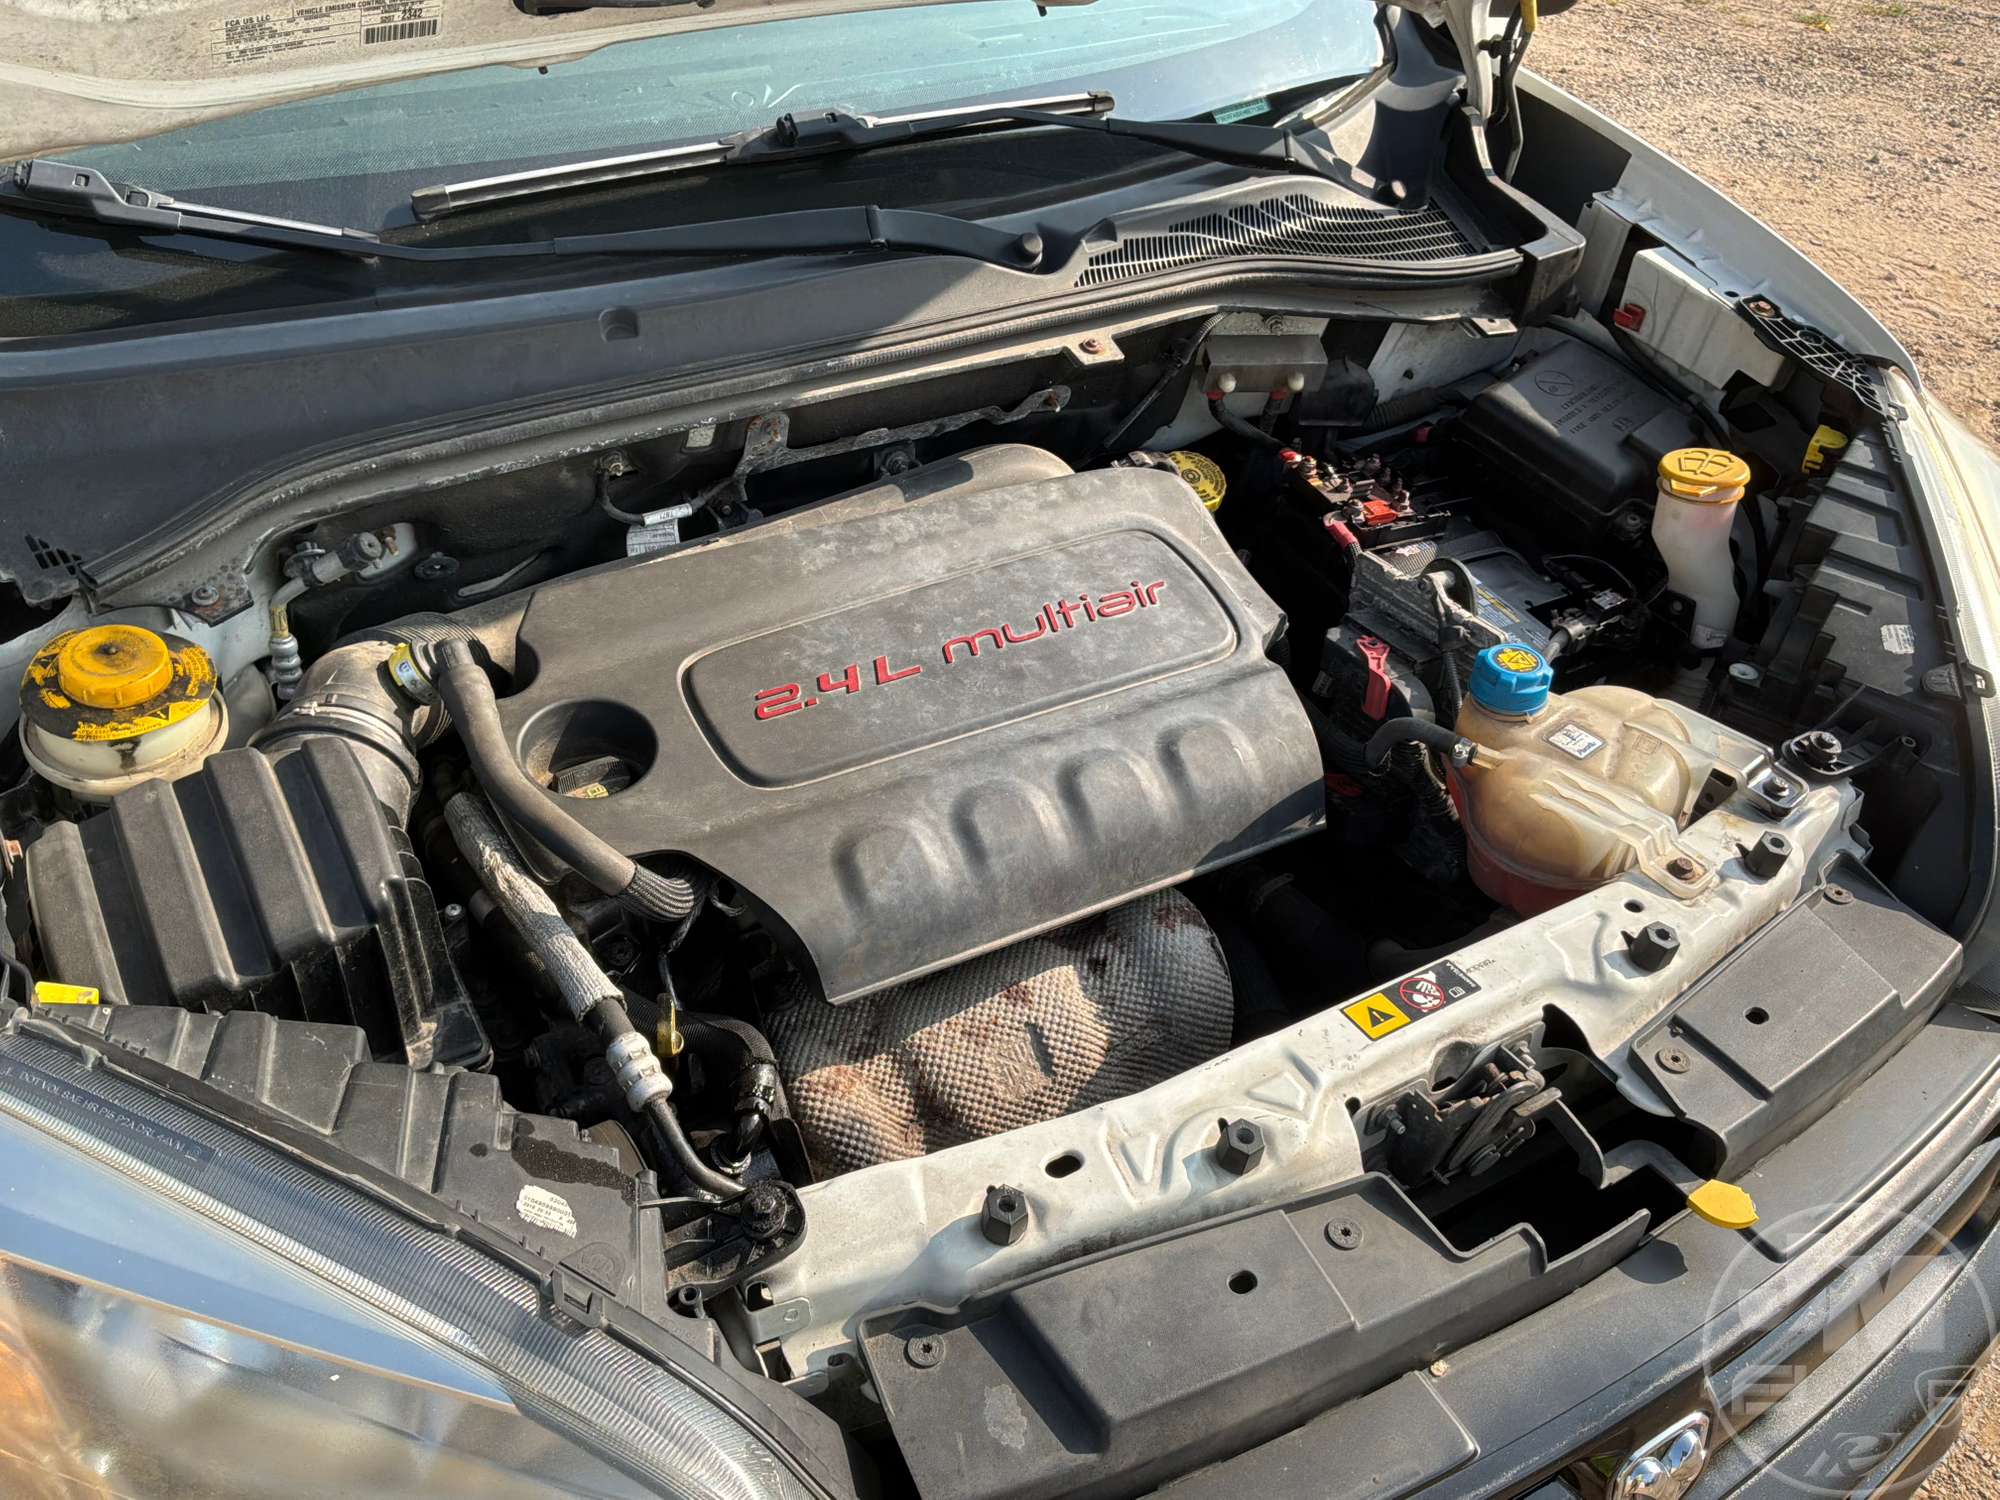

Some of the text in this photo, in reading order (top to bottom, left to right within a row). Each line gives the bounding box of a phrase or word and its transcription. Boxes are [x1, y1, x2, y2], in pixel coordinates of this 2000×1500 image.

[295, 6, 323, 16] VEHICLE
[324, 2, 356, 12] EMISSION
[224, 14, 271, 27] FCA US LLC
[941, 579, 1167, 665] multiair
